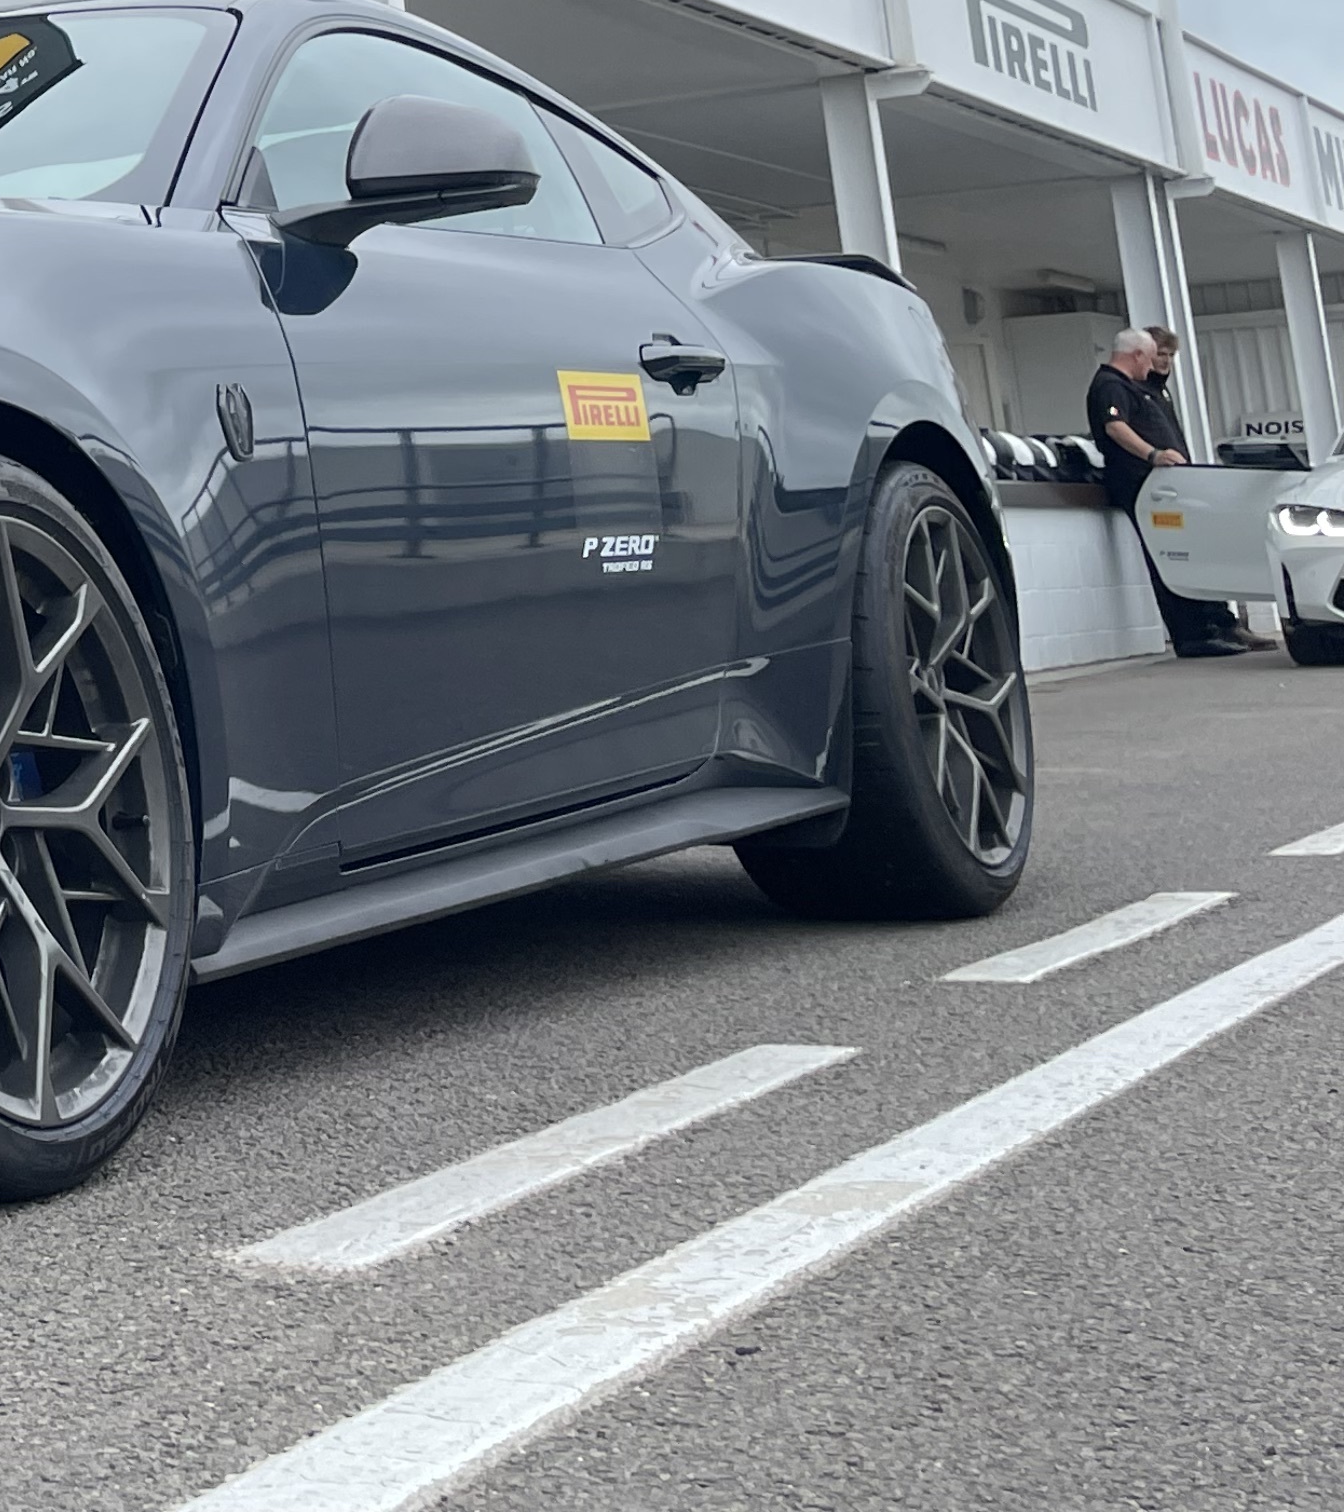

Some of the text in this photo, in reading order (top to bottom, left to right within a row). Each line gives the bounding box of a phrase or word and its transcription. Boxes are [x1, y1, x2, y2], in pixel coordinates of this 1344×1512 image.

[1193, 71, 1291, 188] LUCAS
[567, 384, 641, 427] PIRELLI
[582, 534, 655, 558] P ZERO
